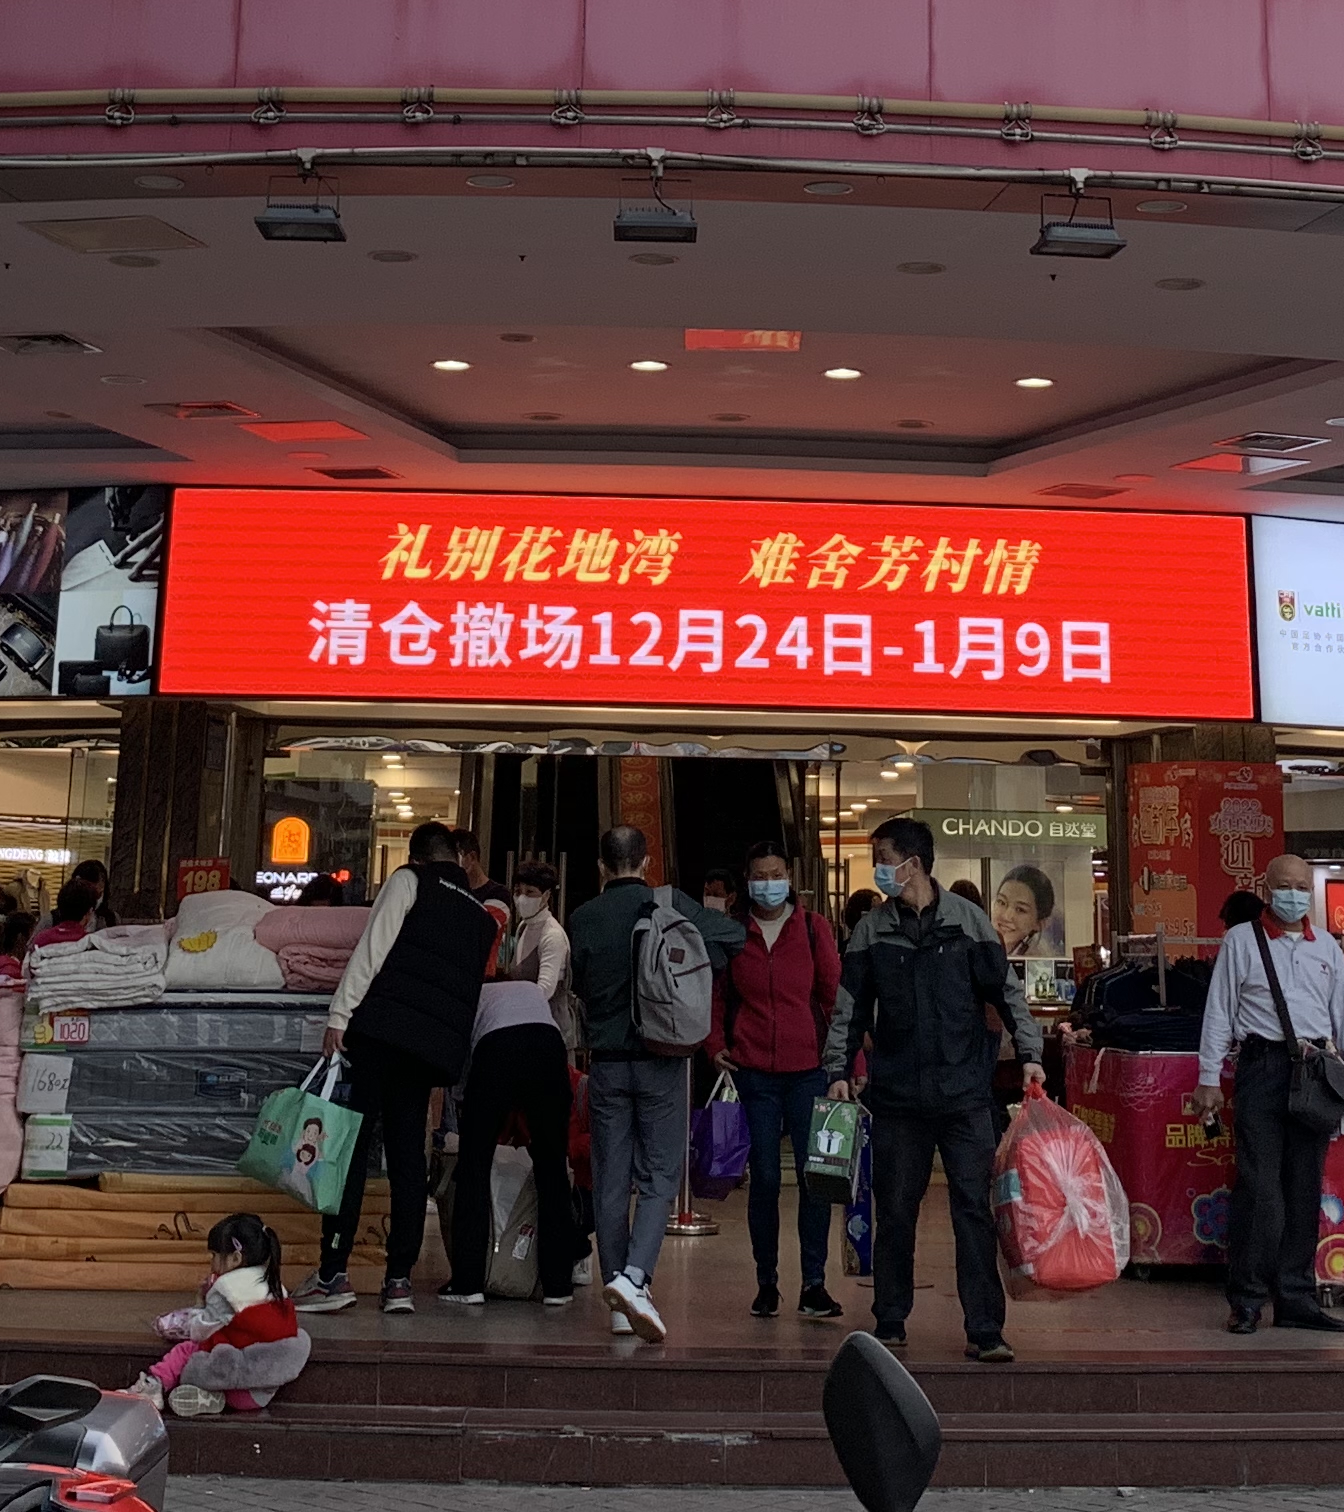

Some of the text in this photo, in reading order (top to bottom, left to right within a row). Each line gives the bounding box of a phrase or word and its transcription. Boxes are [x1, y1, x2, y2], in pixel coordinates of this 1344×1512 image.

[379, 523, 1043, 596] 礼别花地湾 难舍芳村情
[1303, 601, 1341, 619] vatti
[308, 598, 1111, 684] 清仓撤场12月24日-1月9日
[942, 817, 1097, 838] CHANDO 自然堂
[182, 869, 221, 893] 198
[60, 1023, 85, 1041] 1020
